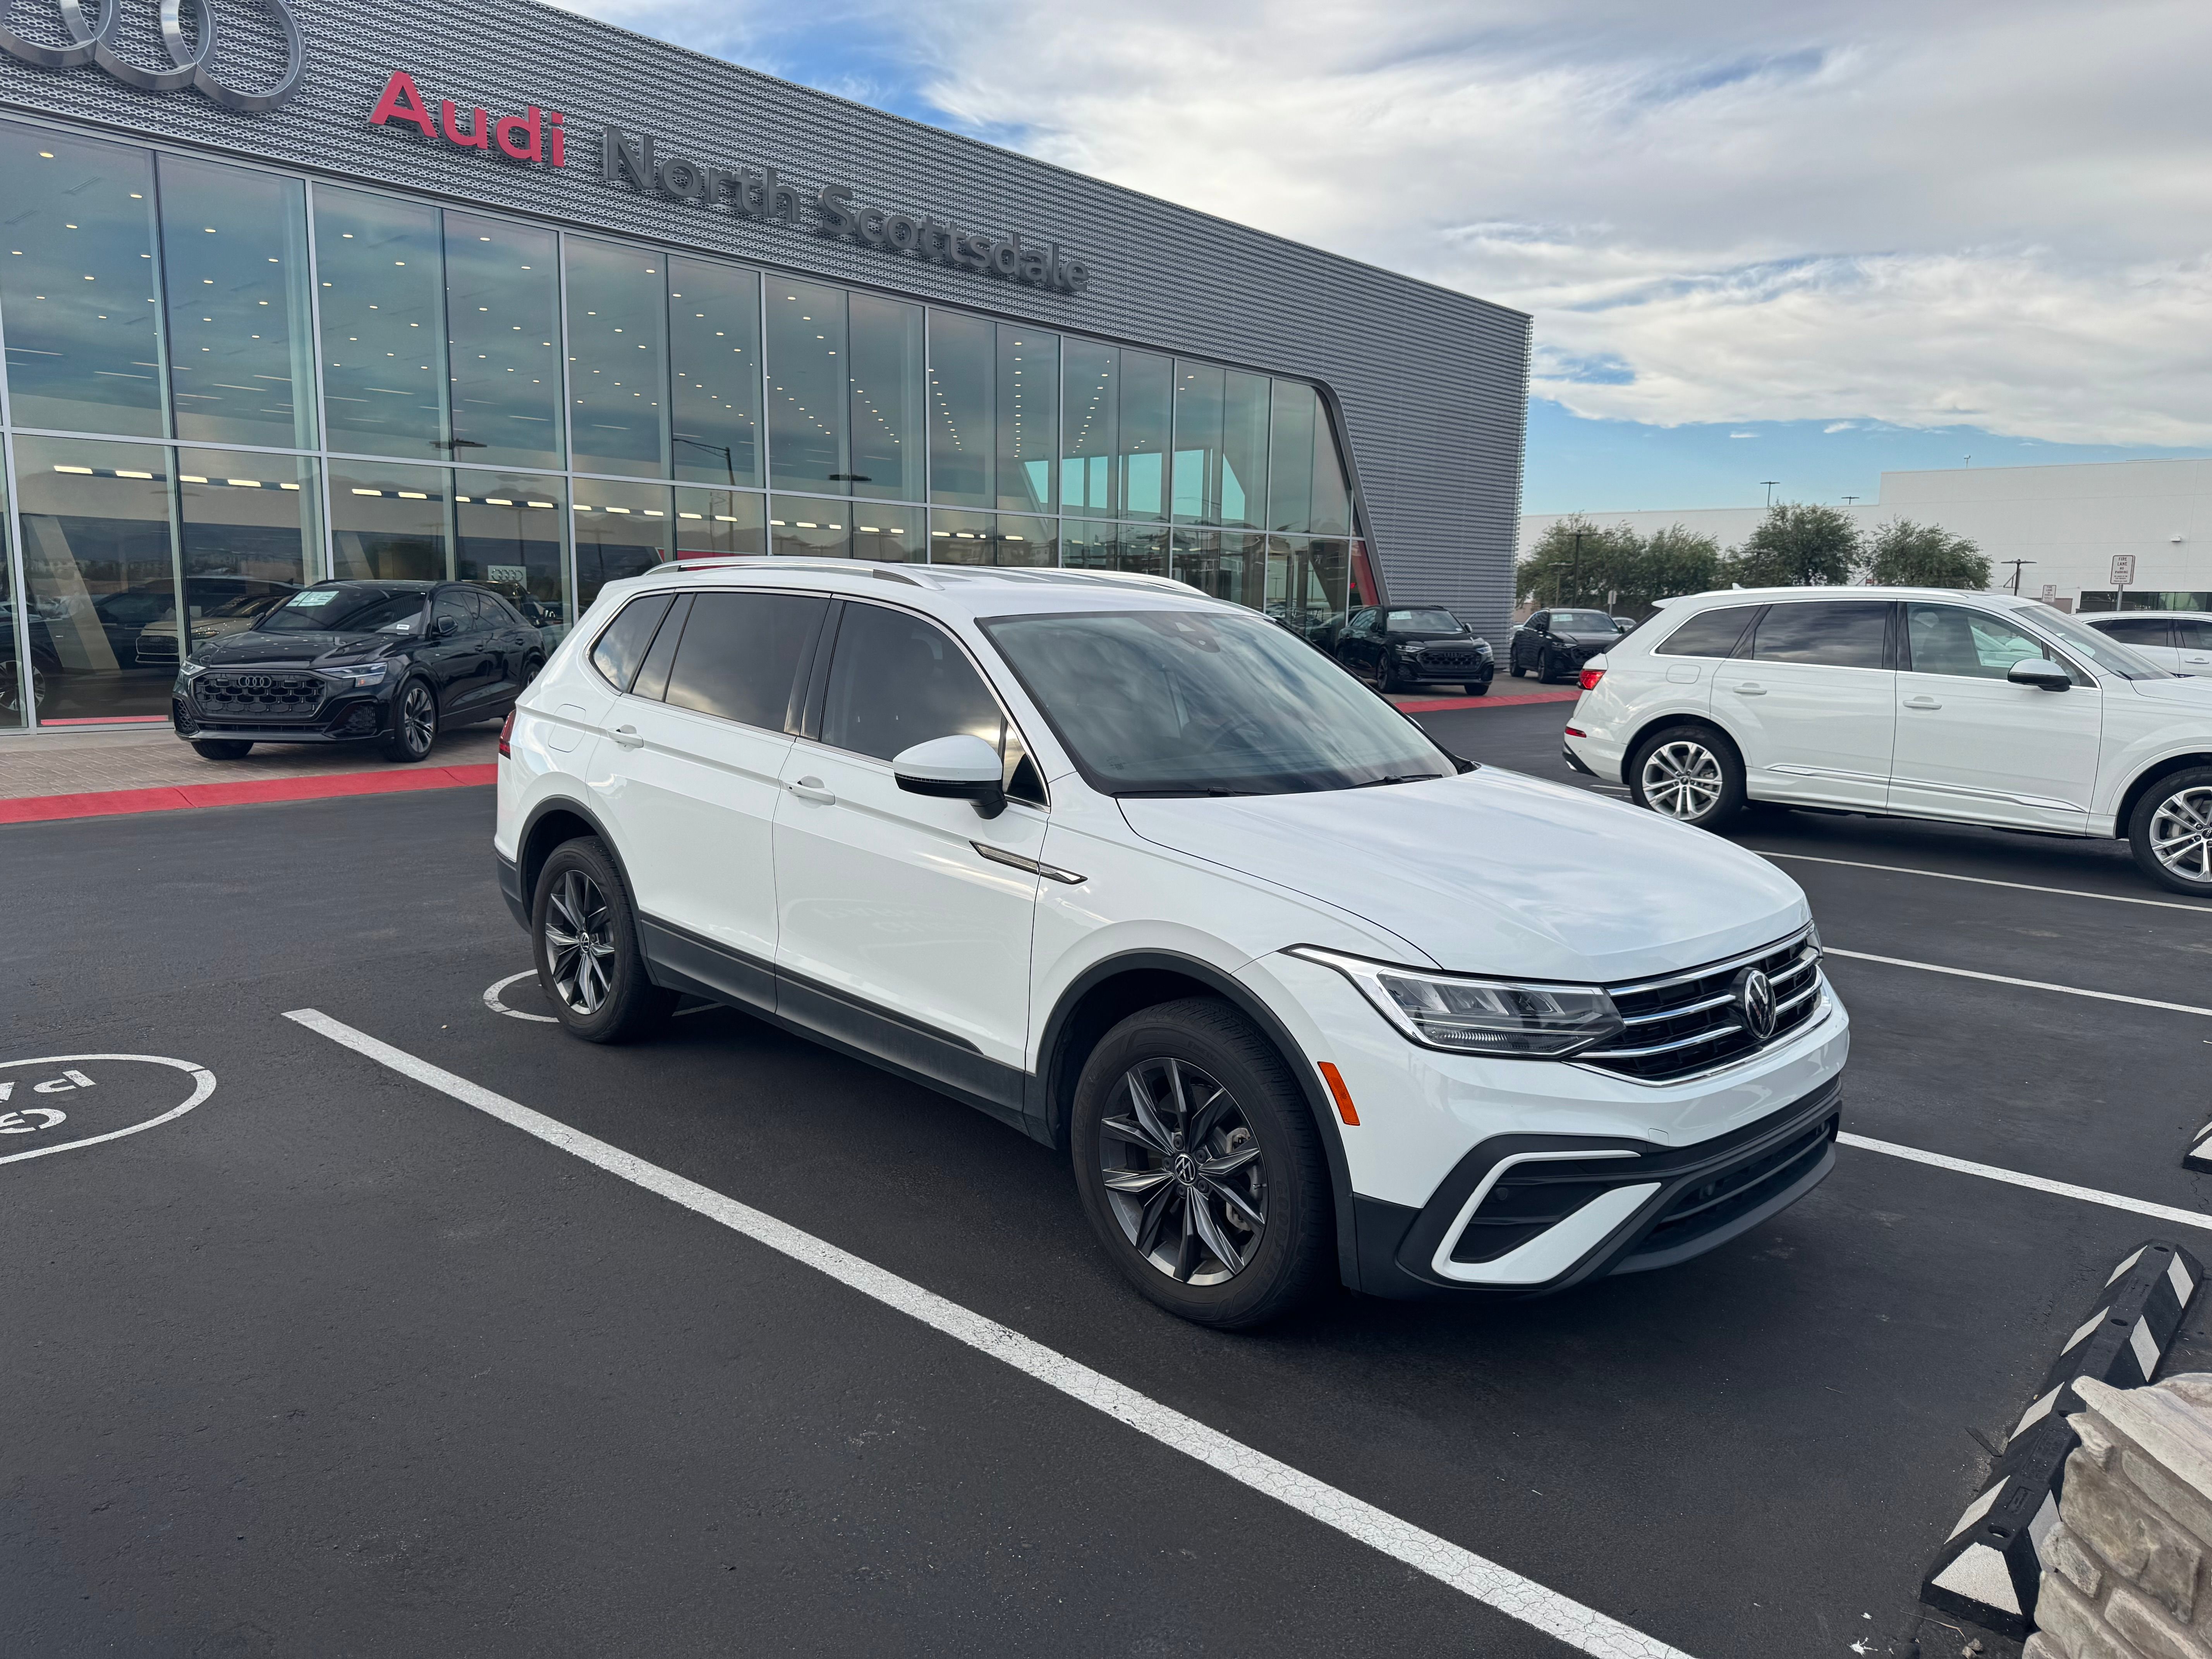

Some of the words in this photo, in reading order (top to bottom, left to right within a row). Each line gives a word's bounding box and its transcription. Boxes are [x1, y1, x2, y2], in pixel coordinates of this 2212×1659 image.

[366, 70, 564, 167] Audi
[603, 126, 800, 223] North
[817, 185, 1089, 292] Scottsdale
